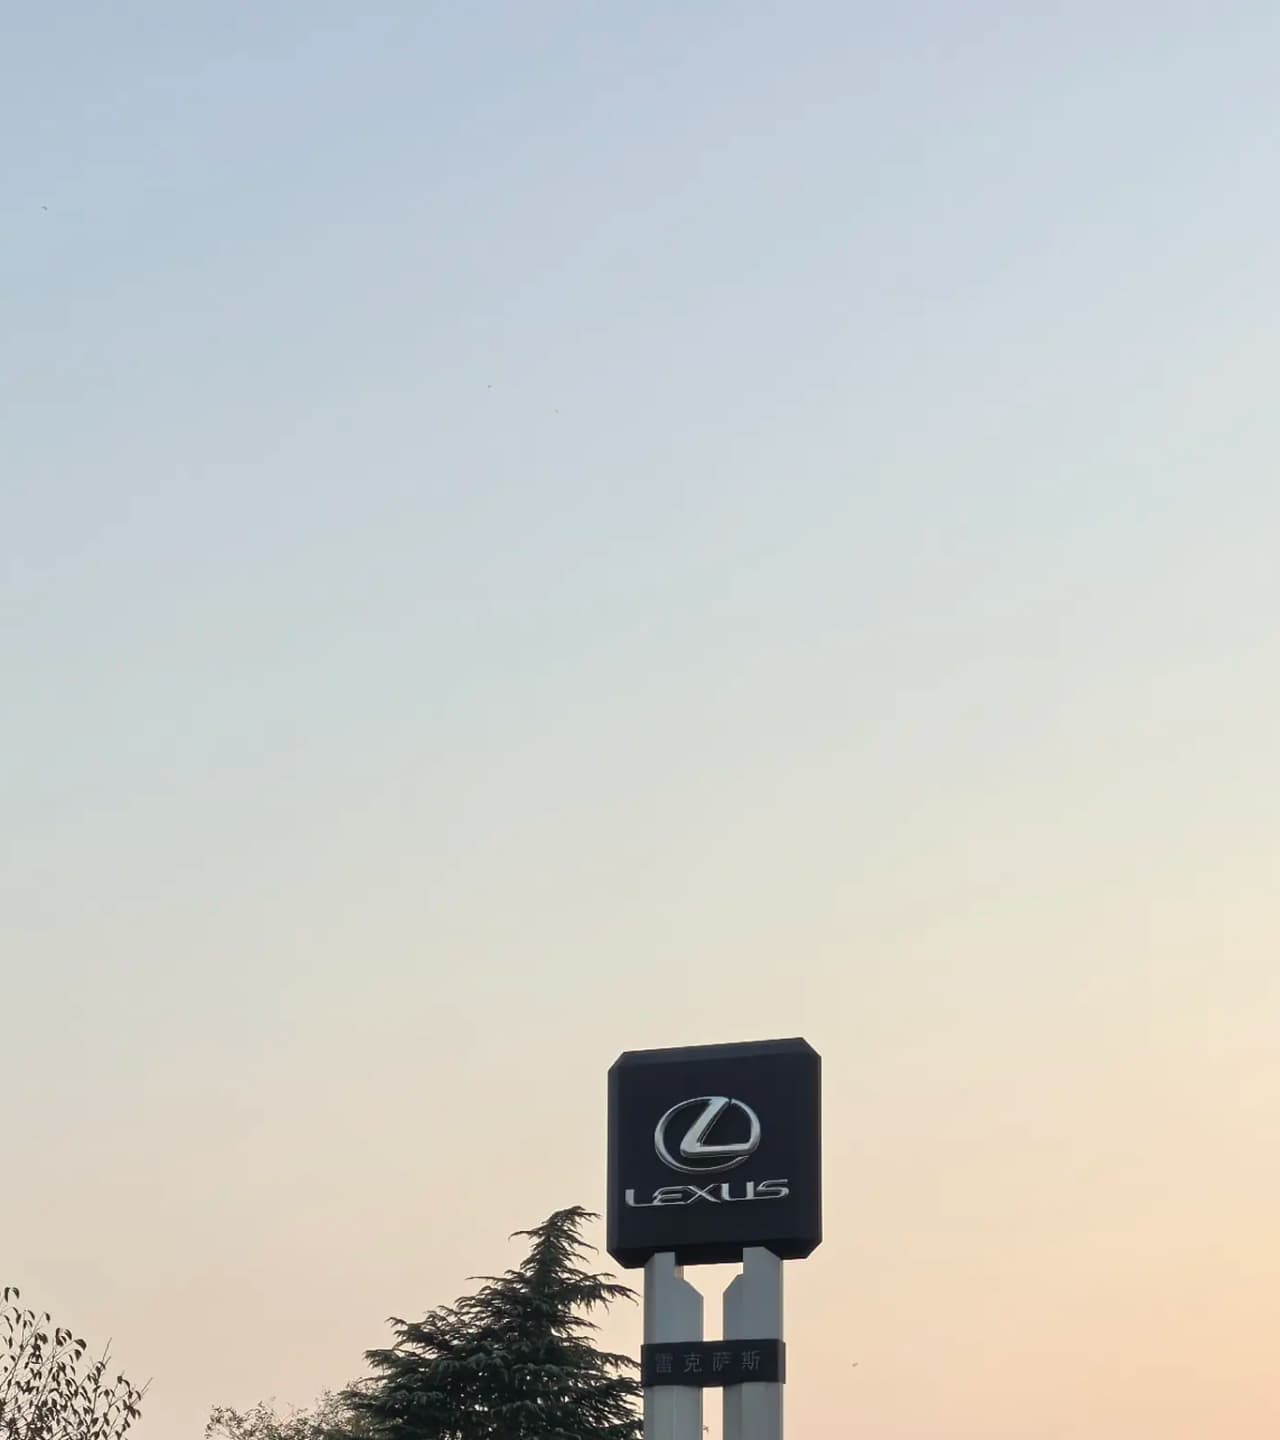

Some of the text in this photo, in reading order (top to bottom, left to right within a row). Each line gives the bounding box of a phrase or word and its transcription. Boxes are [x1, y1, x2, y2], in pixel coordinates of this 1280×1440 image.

[624, 1178, 790, 1207] LEXUS
[655, 1350, 761, 1374] 雷克萨斯
